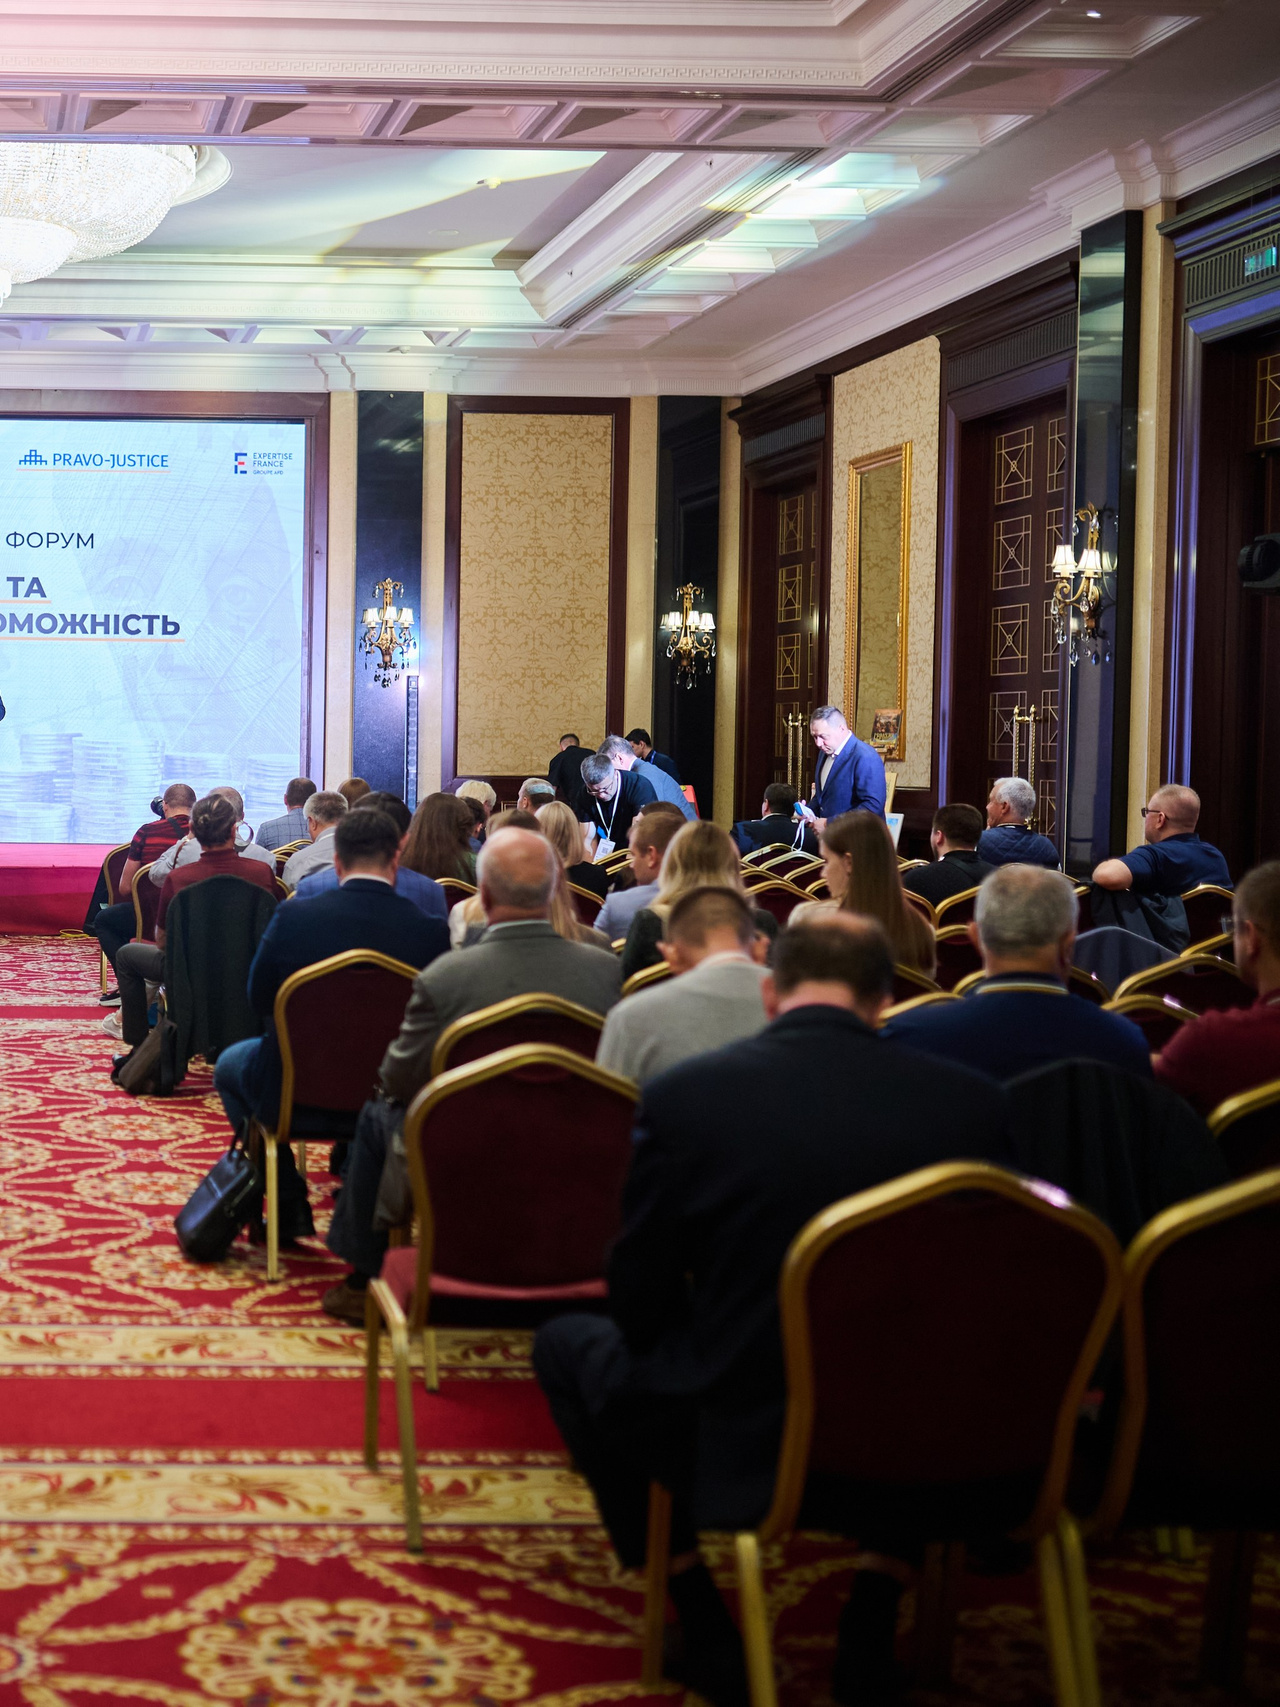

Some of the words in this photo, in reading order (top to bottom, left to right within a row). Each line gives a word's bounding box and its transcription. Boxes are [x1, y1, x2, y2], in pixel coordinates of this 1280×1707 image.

[53, 453, 169, 469] PRAVO-JUSTICE
[253, 452, 293, 460] EXPERTISE
[253, 460, 284, 468] FRANCE
[5, 531, 95, 549] ФОРУМ
[6, 576, 47, 598] ТА
